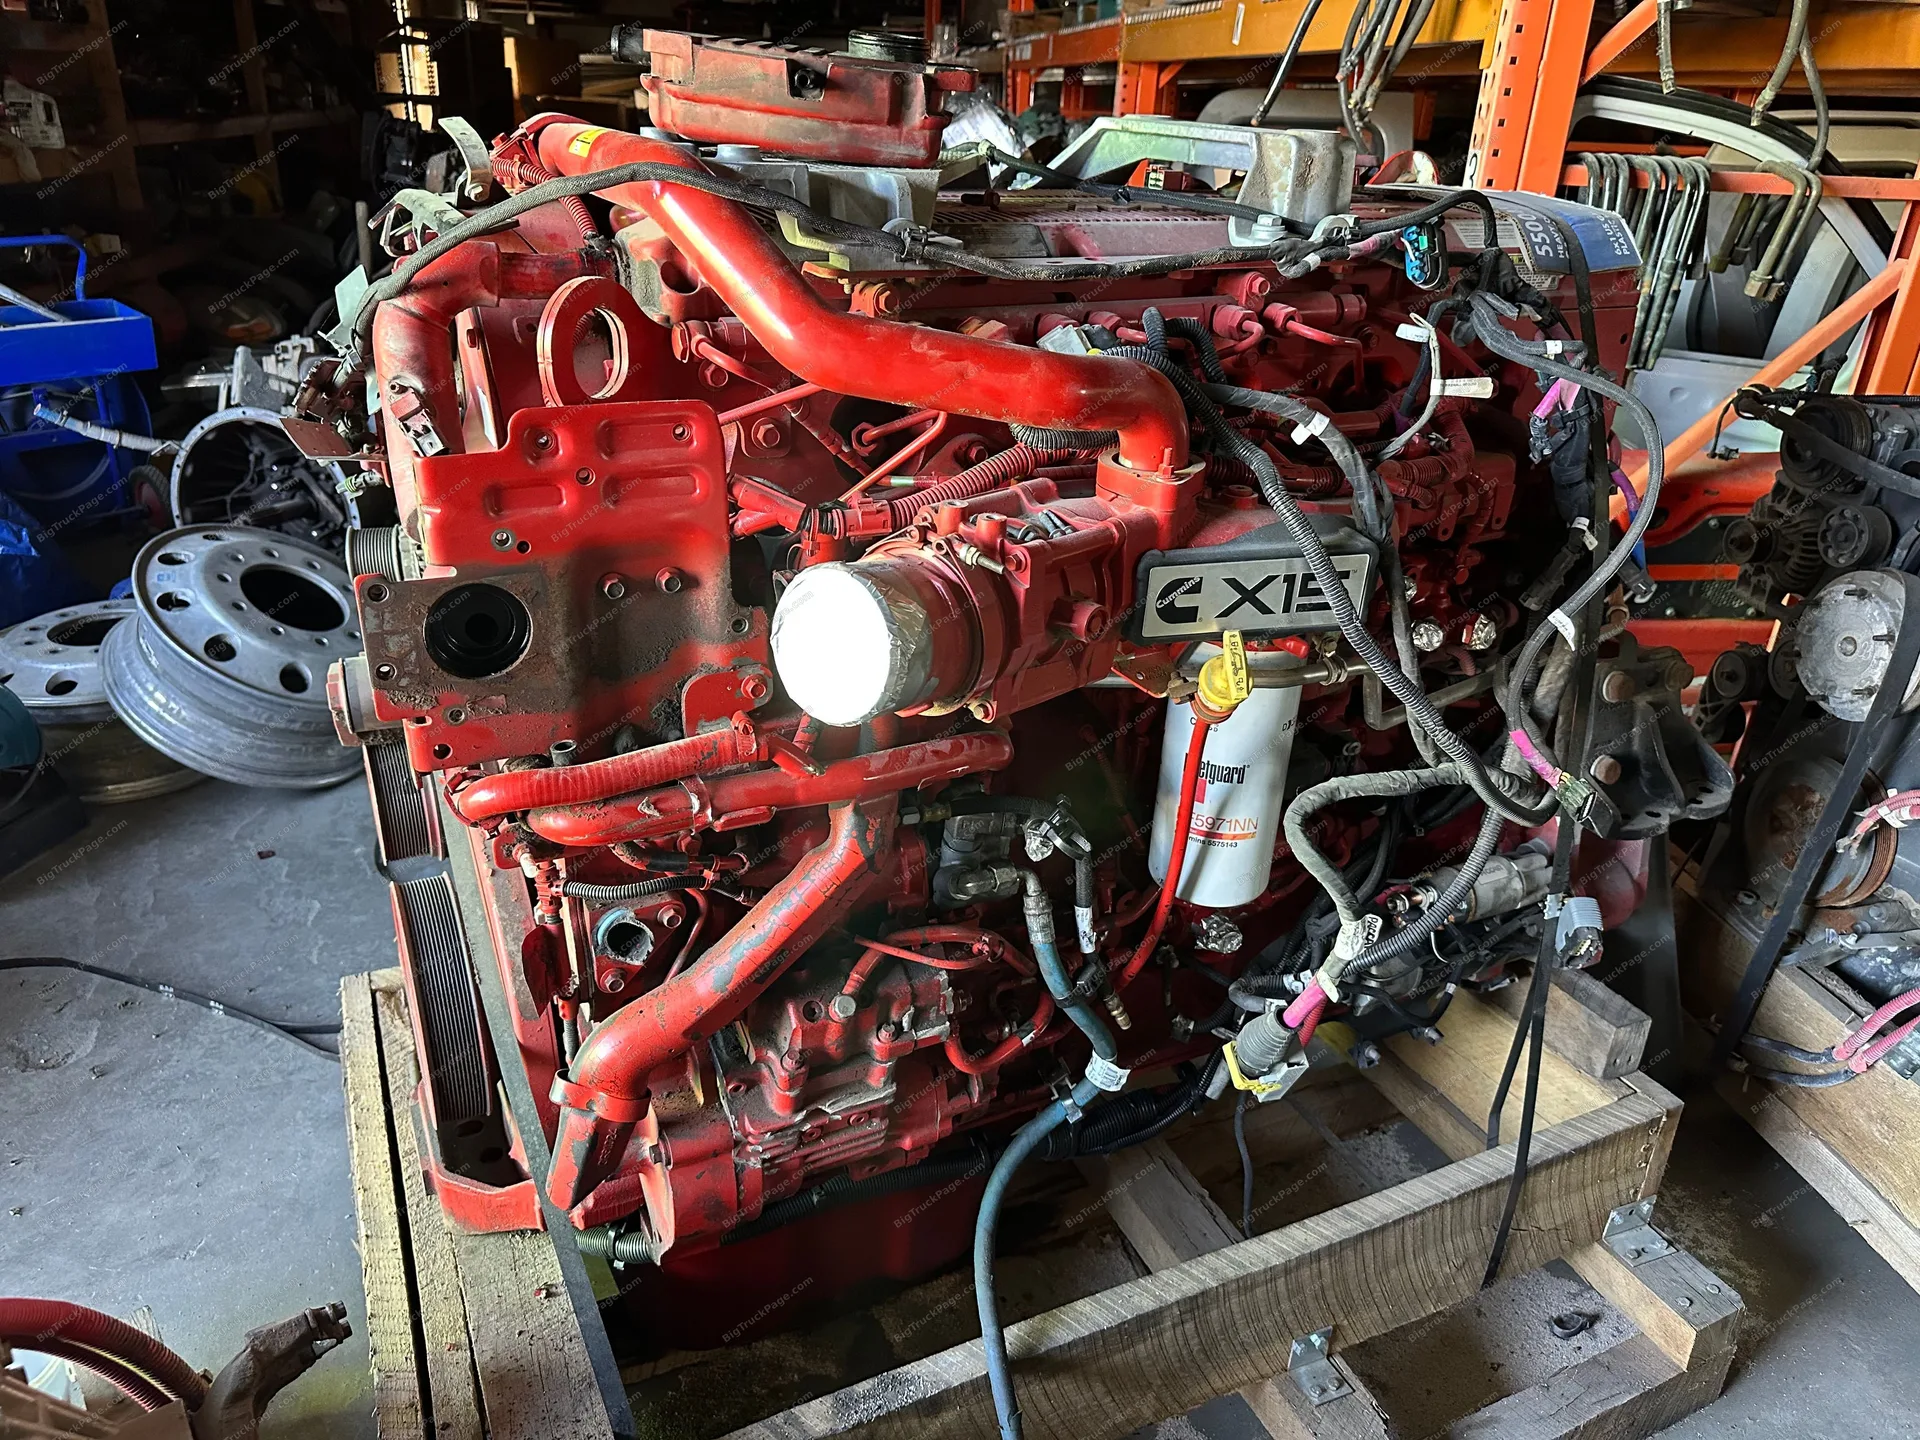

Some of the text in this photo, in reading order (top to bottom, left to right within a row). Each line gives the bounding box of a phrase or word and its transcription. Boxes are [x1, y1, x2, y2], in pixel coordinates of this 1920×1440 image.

[1518, 213, 1553, 257] 5500
[1548, 226, 1565, 259] HEAVY
[1602, 222, 1623, 256] 6x1 US
[1608, 219, 1631, 256] PLASTIC
[1155, 571, 1352, 619] Cummins X15
[1184, 752, 1248, 785] etguard
[1191, 811, 1259, 831] 5971NN
[1188, 835, 1238, 848] mins 5575143
[1363, 915, 1379, 950] PACCA
